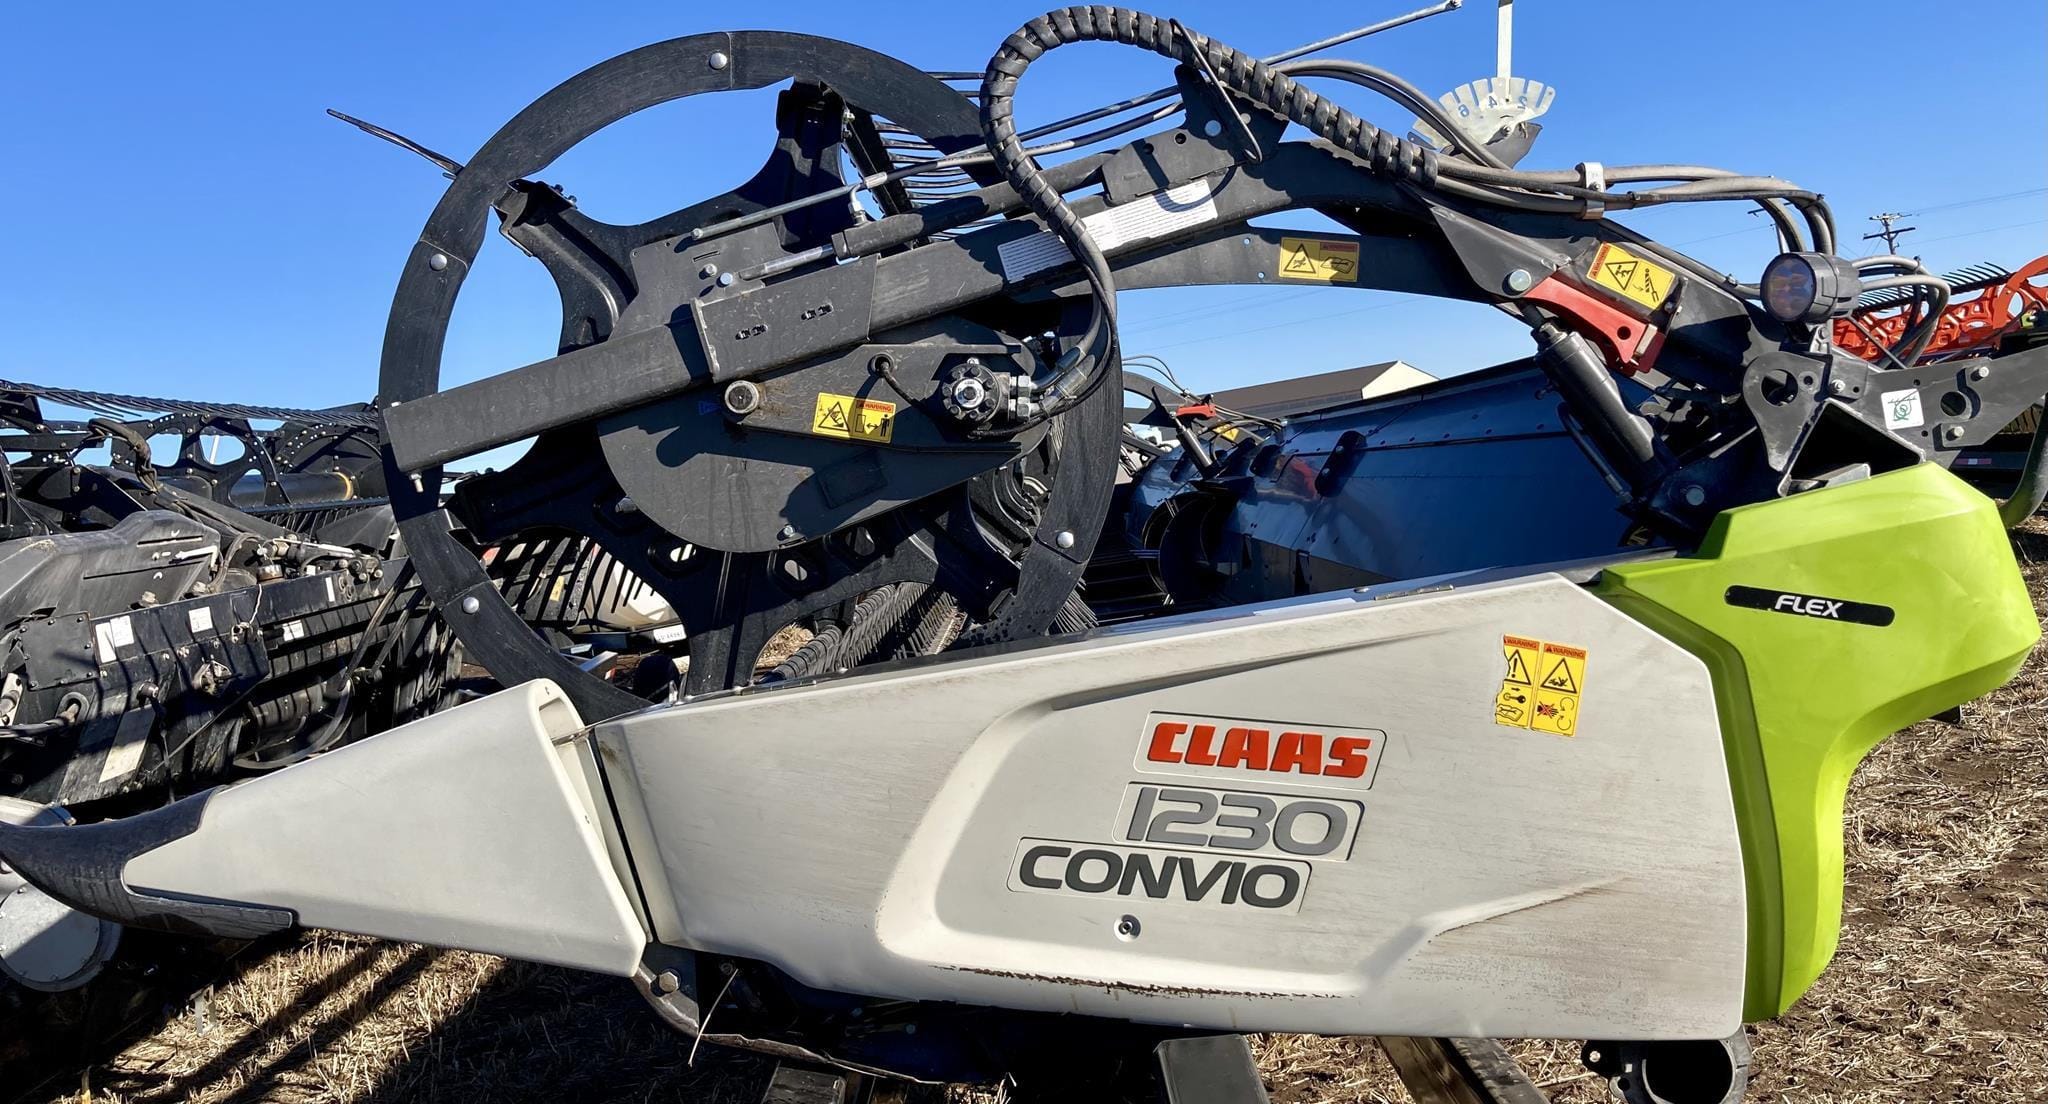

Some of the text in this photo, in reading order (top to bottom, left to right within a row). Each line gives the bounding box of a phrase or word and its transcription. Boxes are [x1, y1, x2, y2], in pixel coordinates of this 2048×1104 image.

[1774, 594, 1844, 618] FLEX
[1506, 637, 1537, 649] WARNING
[1552, 646, 1584, 658] WARNING
[1147, 722, 1371, 779] CLAAS
[1126, 786, 1348, 857] 1230
[1019, 845, 1300, 909] CONVIO
